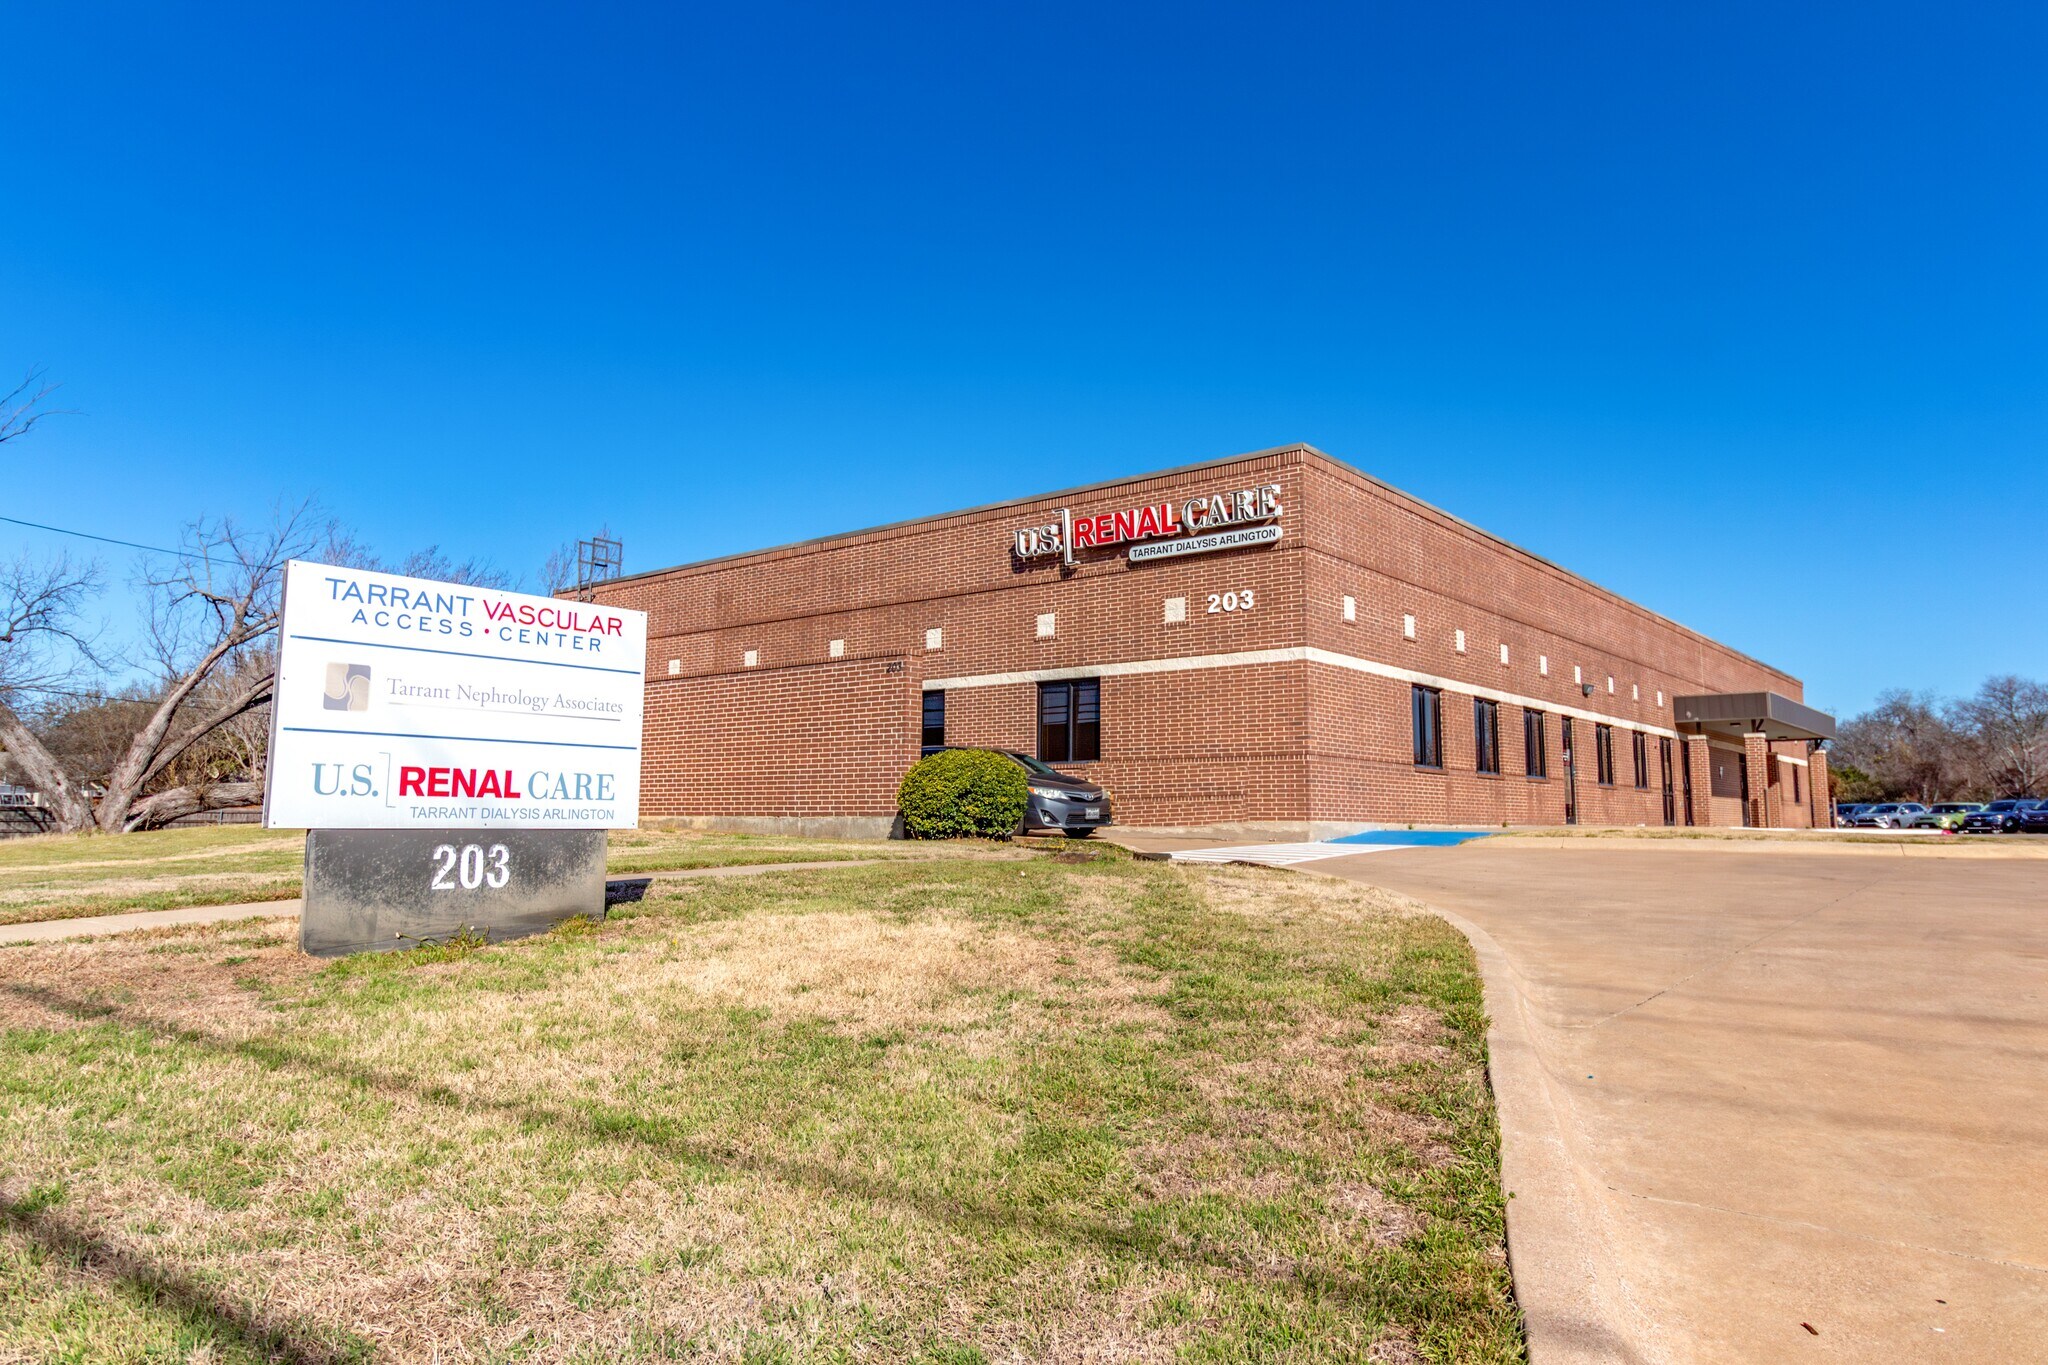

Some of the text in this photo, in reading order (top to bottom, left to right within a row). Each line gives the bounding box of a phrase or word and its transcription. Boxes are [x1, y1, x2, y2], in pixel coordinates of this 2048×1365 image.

[1013, 484, 1284, 558] U.S. RENAL CARE
[1132, 528, 1276, 559] TARRANT DIALYSIS ARLINGTON
[324, 577, 623, 637] TARRANT VASCULAR
[1207, 589, 1255, 614] 203
[351, 609, 601, 653] ACCESS CENTER
[386, 677, 624, 714] Tarrant Nephrology Associates
[311, 763, 616, 801] U.S. RENAL CARE
[410, 806, 615, 821] TARRANT DIALYSIS ARLINGTON
[431, 843, 511, 890] 203
